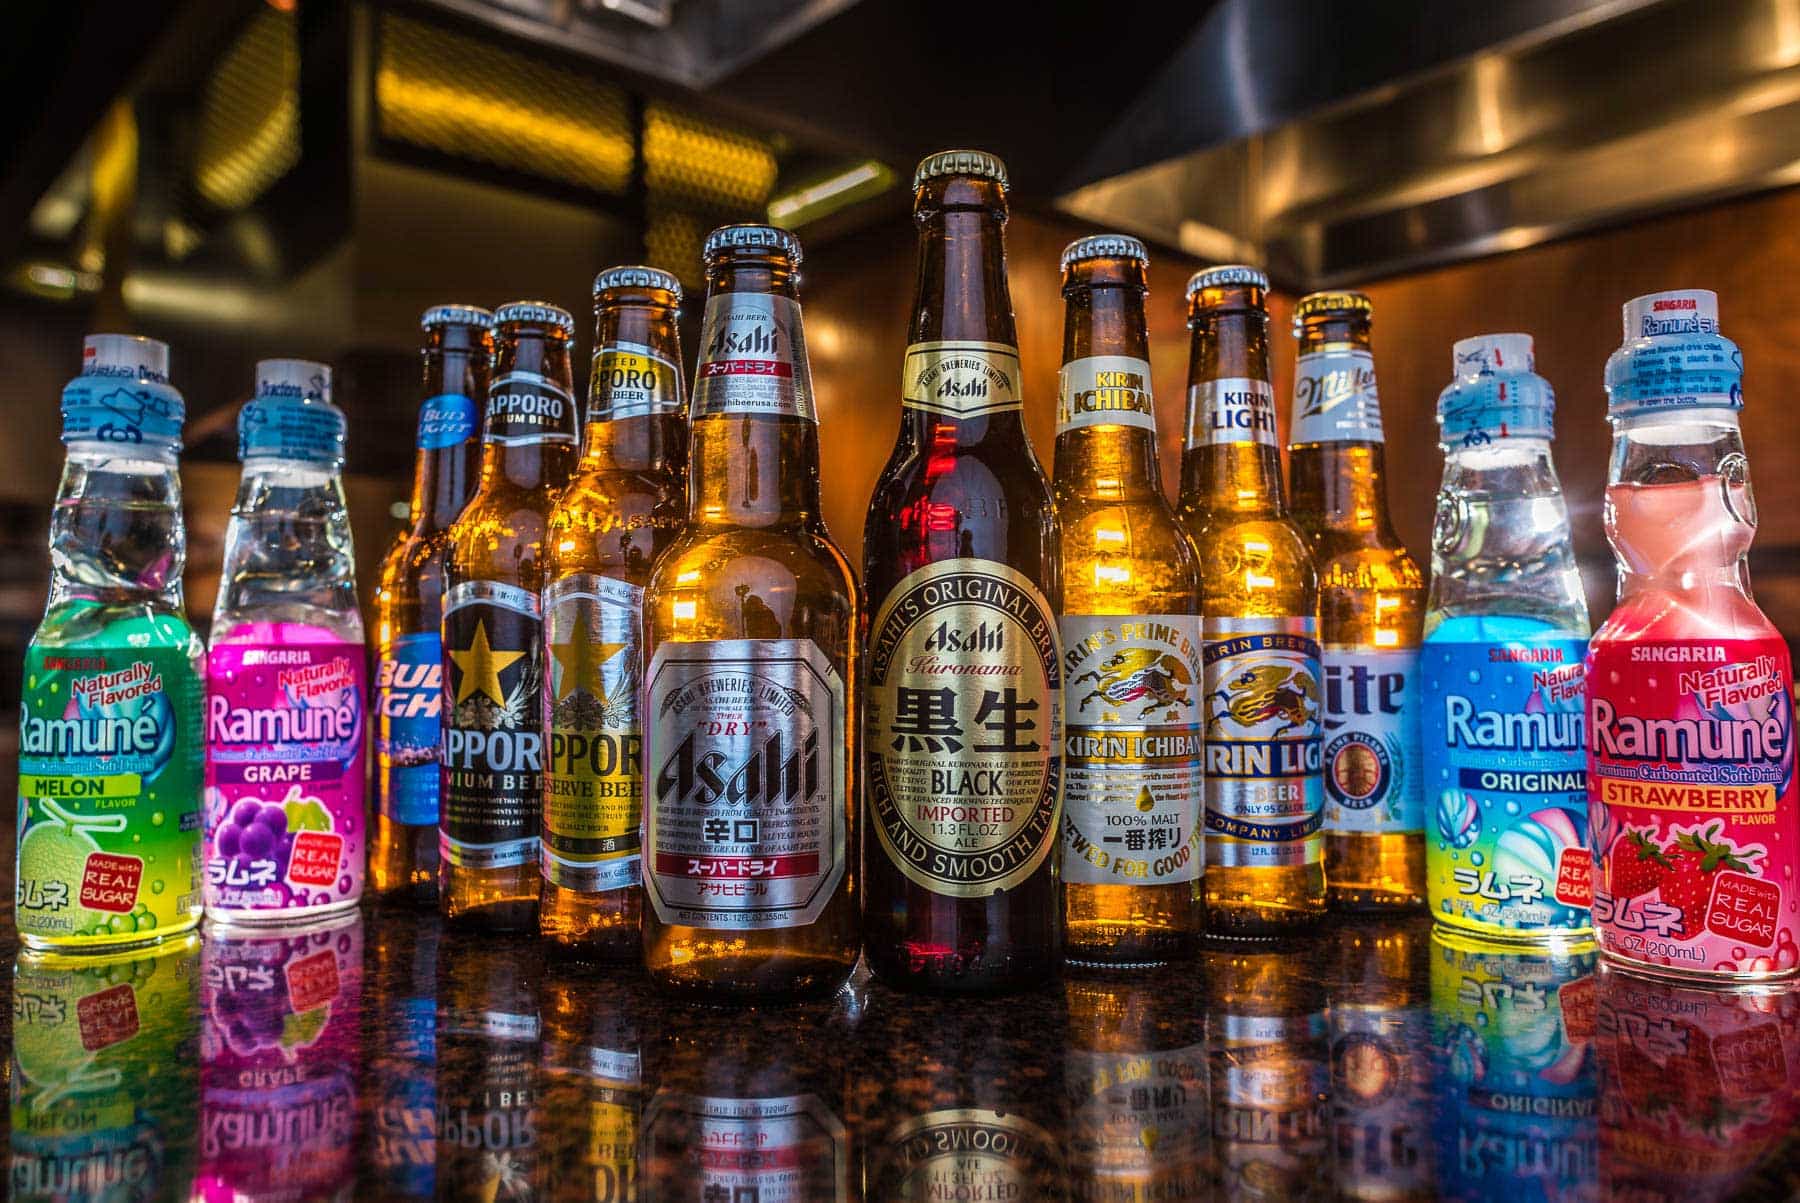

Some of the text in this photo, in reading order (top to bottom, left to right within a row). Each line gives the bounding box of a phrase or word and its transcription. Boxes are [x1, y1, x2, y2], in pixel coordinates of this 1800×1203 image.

[1652, 298, 1697, 312] SANGARIA
[1641, 312, 1698, 337] Ramuné
[708, 325, 778, 356] Asahi
[708, 363, 777, 376] スーパードライ
[941, 359, 981, 373] BREWERIES
[983, 365, 1005, 389] LIMITED
[1096, 371, 1144, 390] KIRIN
[613, 390, 644, 401] BEER
[936, 377, 988, 398] Asahi
[1224, 392, 1270, 406] KIRIN
[484, 393, 563, 419] APPORO
[873, 579, 1060, 682] ASAHI'S ORIGINAL BREW
[924, 620, 1004, 653] Asahi
[1065, 622, 1180, 674] IRIN'S PRIME
[1211, 640, 1252, 660] IRIN
[1488, 647, 1564, 663] SANGARIA
[1631, 646, 1727, 662] SANGARIA
[279, 657, 350, 687] Naturally
[906, 656, 1024, 677] Kuronama
[1533, 663, 1585, 689] Natura
[1680, 656, 1776, 695] Naturally
[72, 661, 153, 696] Naturally
[88, 675, 162, 709] Flavored
[698, 678, 755, 697] BREWERIES
[759, 684, 796, 718] LIMITED
[1324, 665, 1404, 717] ite
[1704, 671, 1783, 711] Flavored
[20, 699, 160, 755] Ramuné
[210, 690, 353, 745] Ramuné
[697, 721, 768, 737] "DRY"
[891, 687, 1041, 755] 黒生
[1446, 695, 1586, 748] Ramun
[1591, 699, 1784, 763] Ramuné
[440, 728, 542, 772] APPOR
[1065, 736, 1127, 759] KIRIN
[1207, 741, 1323, 775] RIN LIG
[244, 764, 312, 782] GRAPE
[656, 728, 818, 806] Asahi
[1639, 765, 1719, 784] Carbonated
[1751, 766, 1784, 784] Drink
[35, 779, 104, 796] MELON
[503, 774, 544, 790] BEE
[543, 779, 643, 798] SERVE BEE
[931, 769, 1004, 796] BLACK
[1255, 784, 1299, 801] BEER
[1481, 772, 1585, 791] ORIGINAL
[95, 799, 136, 809] FLAVOR
[1607, 783, 1769, 810] STRAWBERRY
[872, 761, 895, 817] RICH
[888, 820, 928, 862] AND
[932, 834, 1034, 879] SMOOTH
[917, 804, 1015, 823] IMPORTED
[1105, 813, 1181, 827] 100% MALT
[1235, 804, 1276, 814] ONLY 95
[1731, 814, 1777, 826] FLAVOR
[704, 818, 760, 844] 辛口
[1103, 827, 1182, 851] 一番搾り
[954, 837, 979, 849] ALE
[1066, 815, 1191, 878] EWED FOR GOOD
[89, 858, 118, 871] MADE
[294, 849, 337, 864] REAL
[688, 860, 778, 876] スーパードライ
[85, 871, 137, 889] REAL
[208, 858, 277, 886] ラムネ
[1561, 865, 1591, 881] REA
[82, 887, 133, 906] SUGAR
[698, 881, 768, 897] アサヒビール
[1454, 867, 1544, 904] ラムネ
[1558, 883, 1591, 899] SUGA
[1719, 880, 1778, 901] MADE with
[692, 911, 729, 922] CONTENTS
[1595, 891, 1685, 938] ラムネ
[1715, 893, 1777, 921] REAL
[1711, 911, 1774, 940] SUGAR
